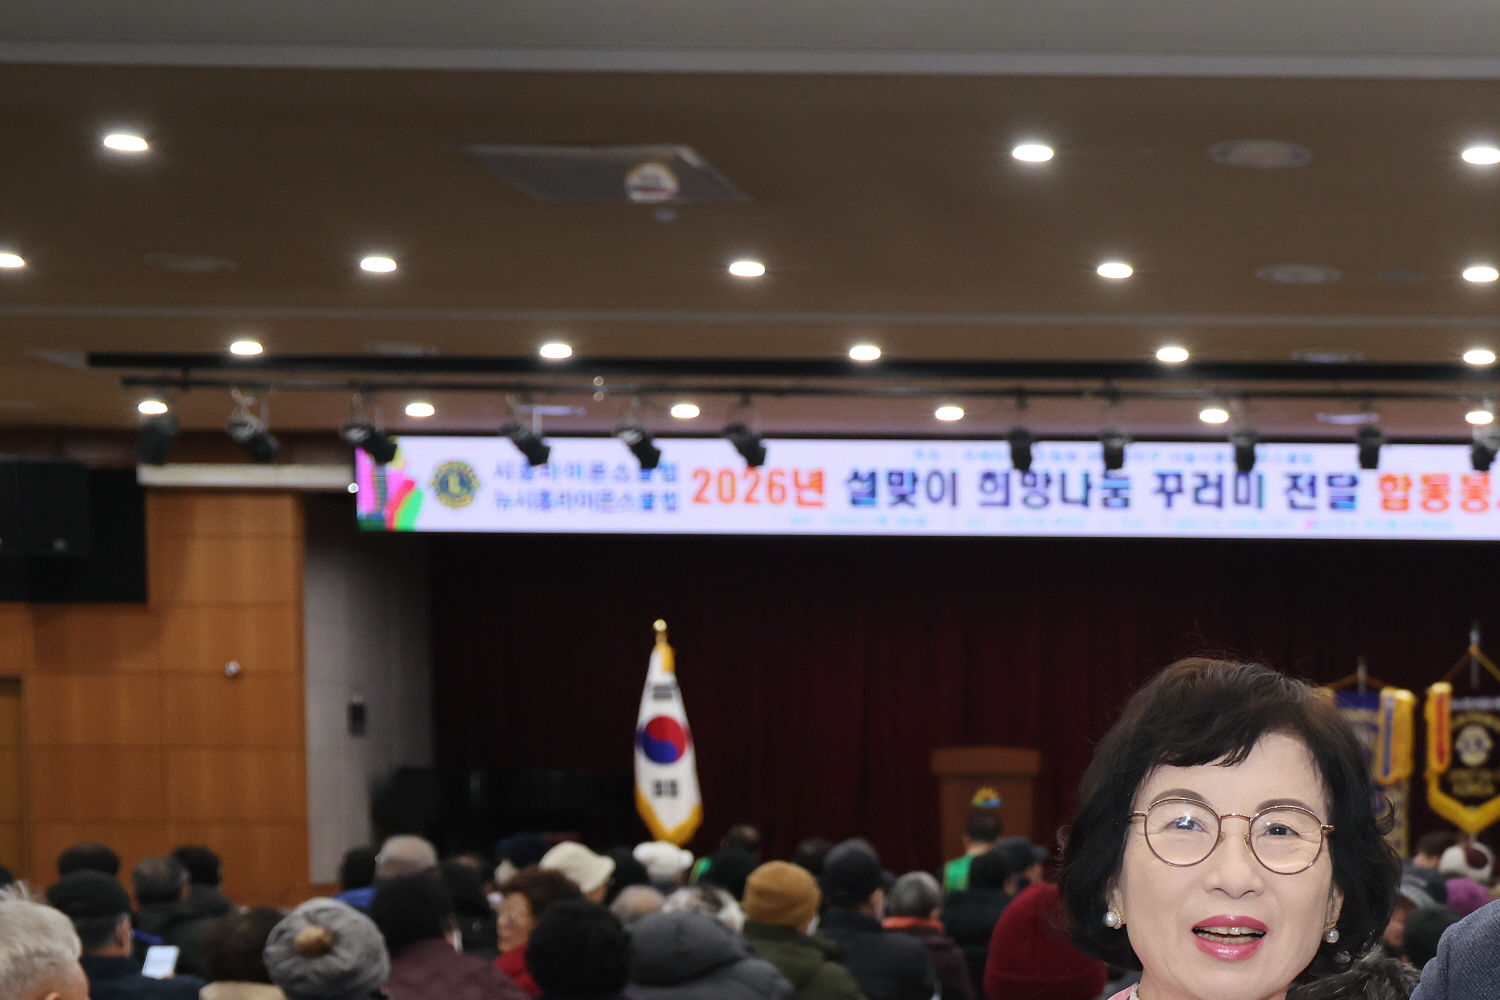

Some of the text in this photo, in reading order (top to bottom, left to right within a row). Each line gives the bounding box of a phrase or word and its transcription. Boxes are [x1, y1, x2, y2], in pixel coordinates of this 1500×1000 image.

[692, 467, 825, 507] 2026년
[845, 468, 960, 508] 설맞이
[978, 469, 1131, 509] 희망나눔
[1151, 470, 1265, 509] 꾸러미
[1282, 471, 1359, 511] 전달
